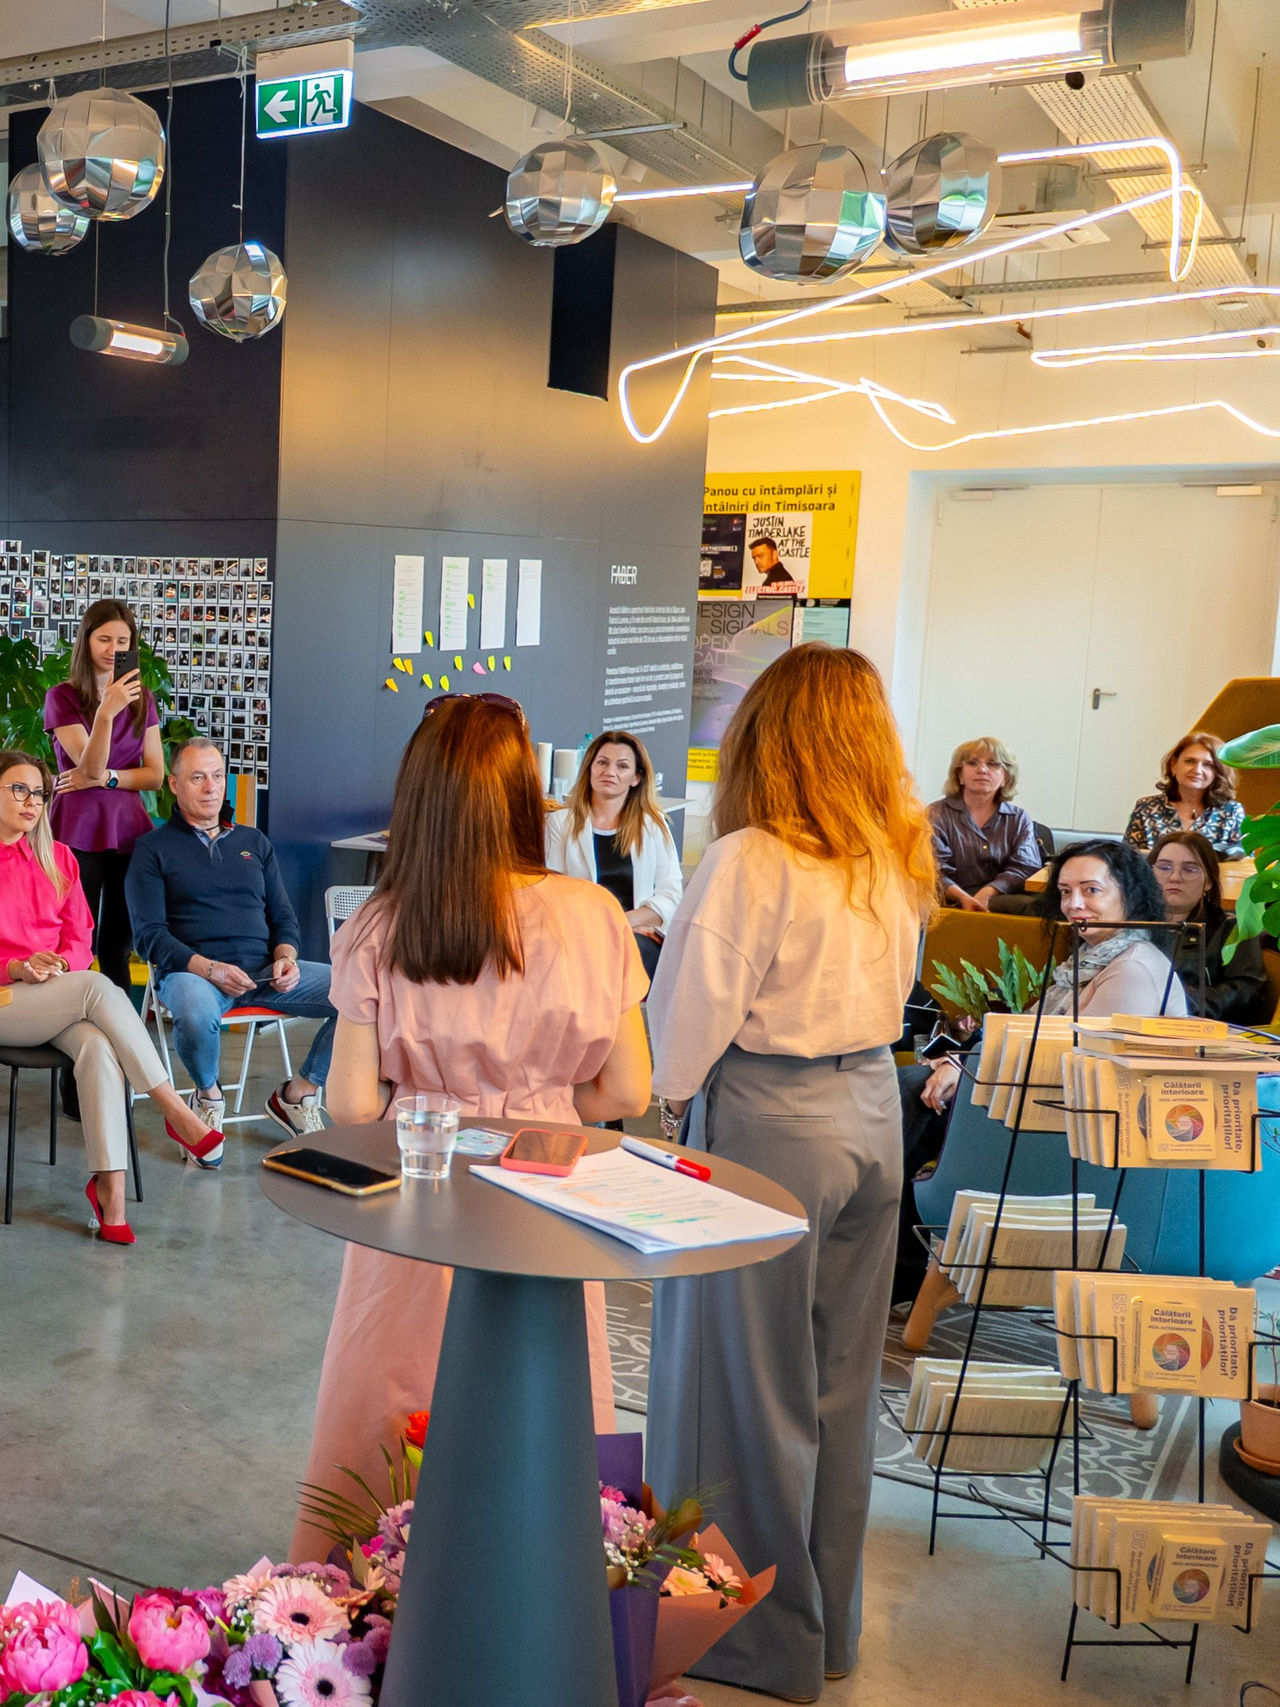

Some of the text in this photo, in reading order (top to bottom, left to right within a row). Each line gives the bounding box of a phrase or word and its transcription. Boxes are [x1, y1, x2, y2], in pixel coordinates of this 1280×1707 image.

[704, 486, 738, 497] Panou
[742, 487, 756, 496] cu
[759, 484, 823, 497] întâmplări
[752, 502, 771, 512] din
[752, 515, 784, 528] JUSTIN
[748, 526, 806, 539] TIMBERLAKE
[778, 539, 806, 548] AT THE
[778, 547, 810, 558] CASTLE
[610, 565, 638, 585] FABER
[696, 603, 755, 618] ESIGN
[1232, 1098, 1243, 1153] prioritate,
[1112, 1293, 1126, 1313] 55
[1150, 1316, 1193, 1326] interioare
[1228, 1324, 1238, 1379] prioritate,
